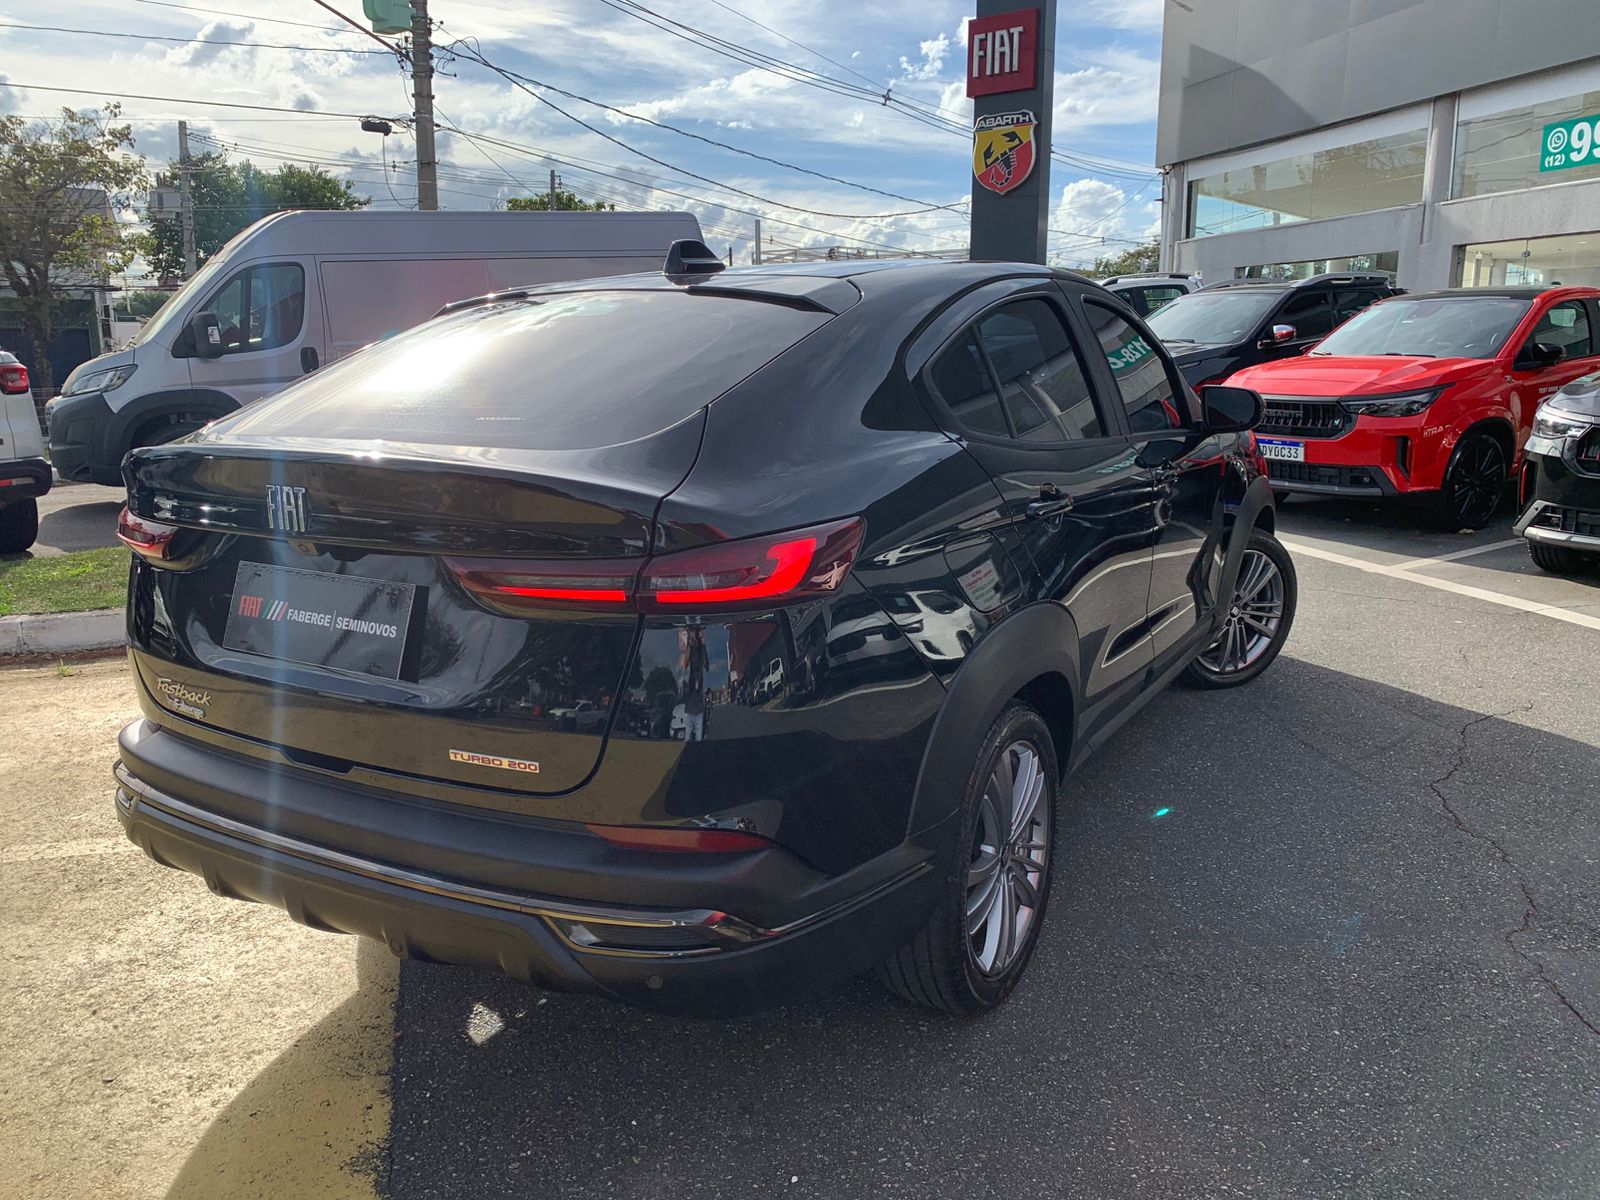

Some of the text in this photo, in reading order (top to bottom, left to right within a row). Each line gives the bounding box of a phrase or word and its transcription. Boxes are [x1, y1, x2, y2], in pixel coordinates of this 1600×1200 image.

[973, 26, 1024, 78] FIAT
[978, 114, 1030, 129] ABARTH
[1544, 153, 1566, 168] (12)
[266, 484, 306, 532] FIAT
[238, 595, 398, 639] FIAT FABERGE SEMINOVOS
[156, 677, 211, 706] Fastback
[450, 751, 538, 772] TURBO 200
